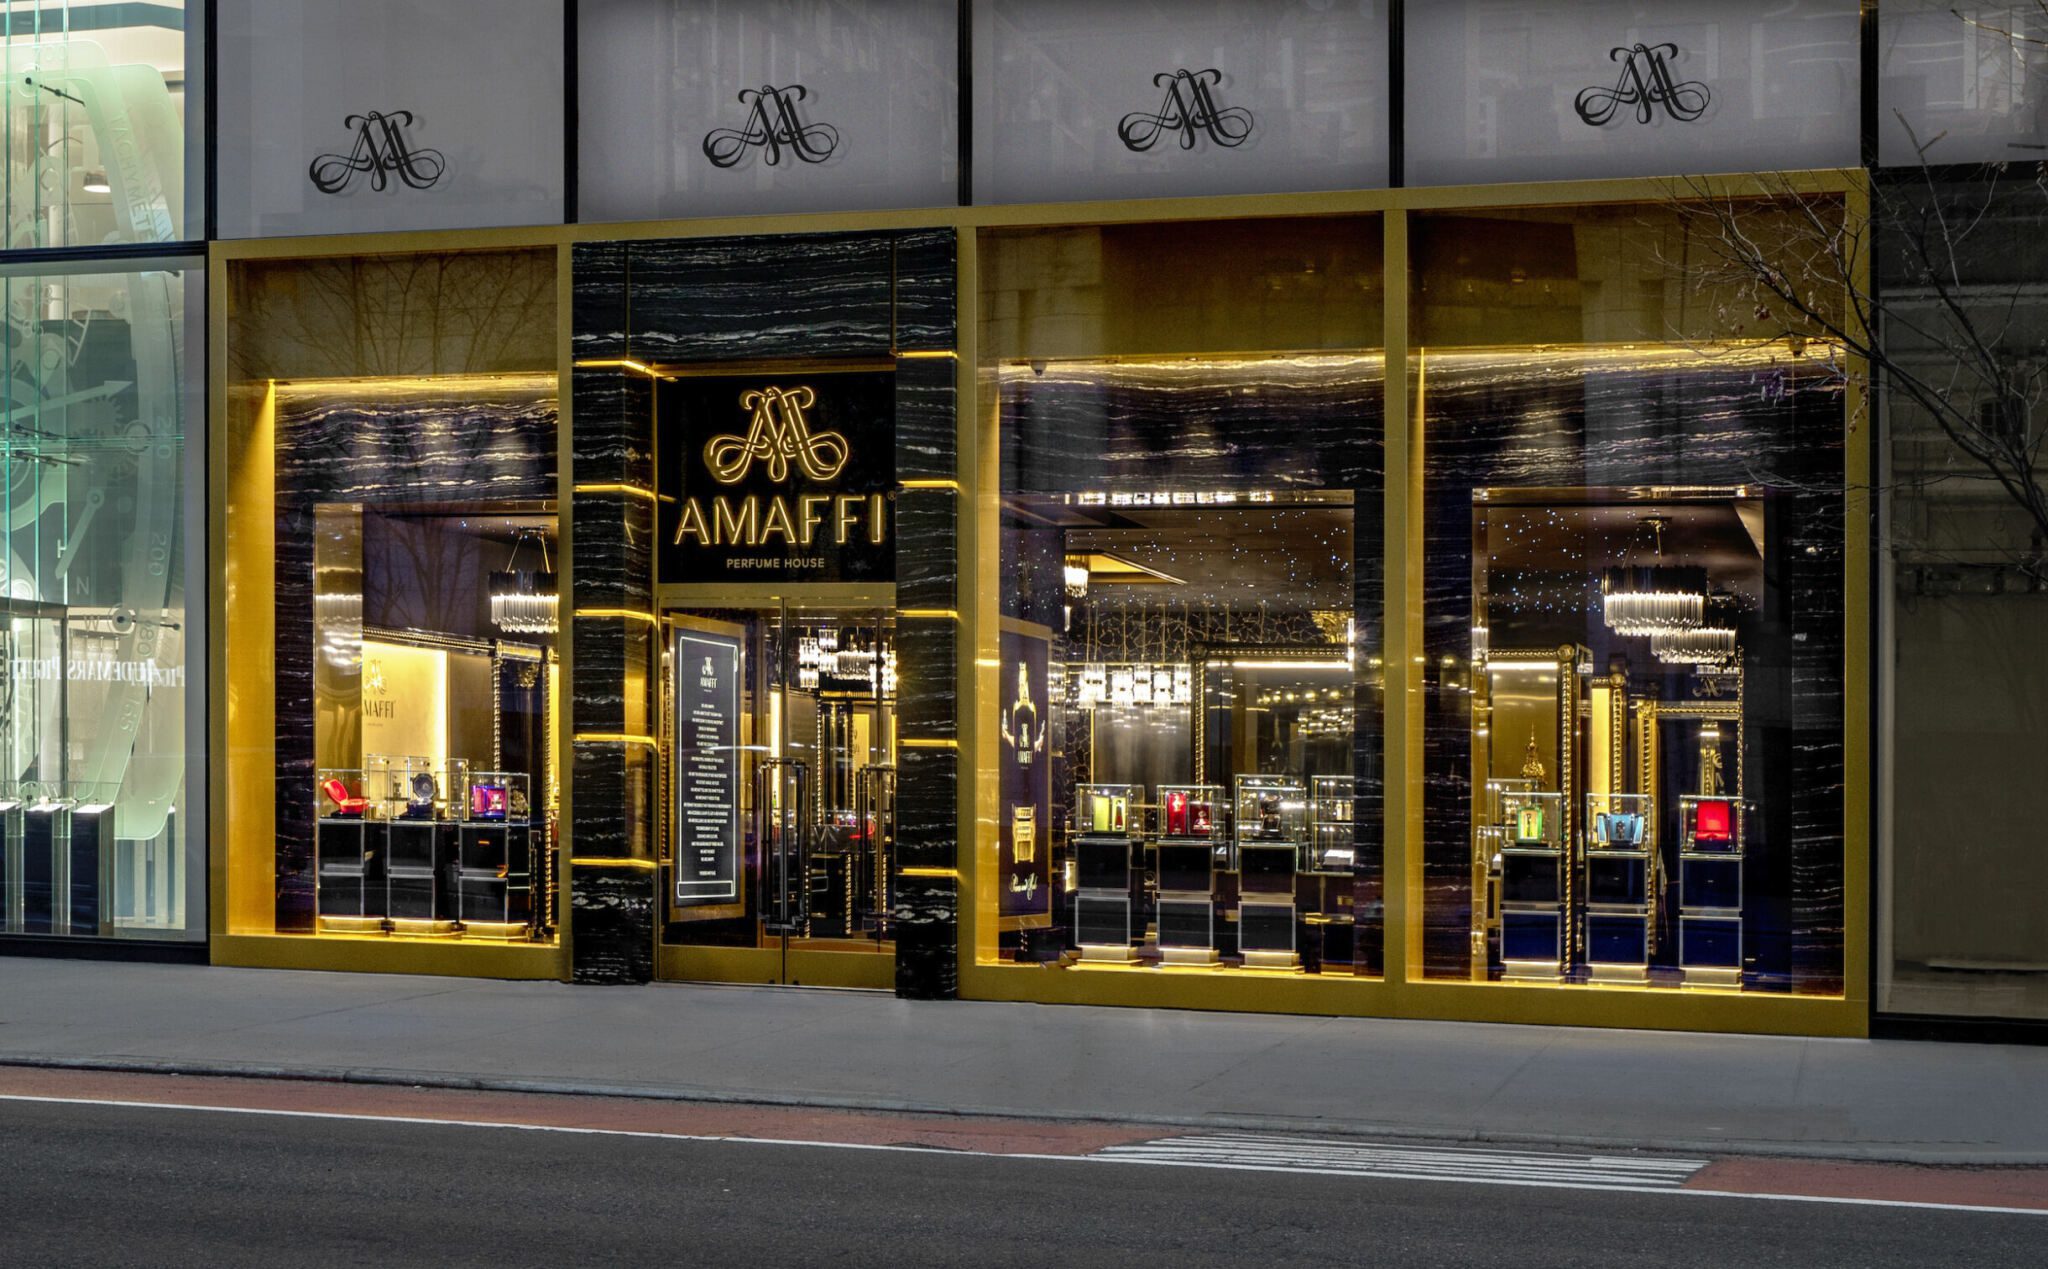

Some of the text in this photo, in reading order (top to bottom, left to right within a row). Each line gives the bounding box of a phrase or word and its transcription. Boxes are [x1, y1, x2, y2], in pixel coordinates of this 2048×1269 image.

[112, 113, 158, 243] TACHYMETE
[157, 416, 172, 459] 20
[673, 494, 884, 545] AMAFFI
[727, 557, 825, 569] PERFUME HOUSE
[362, 699, 394, 719] MAFFI
